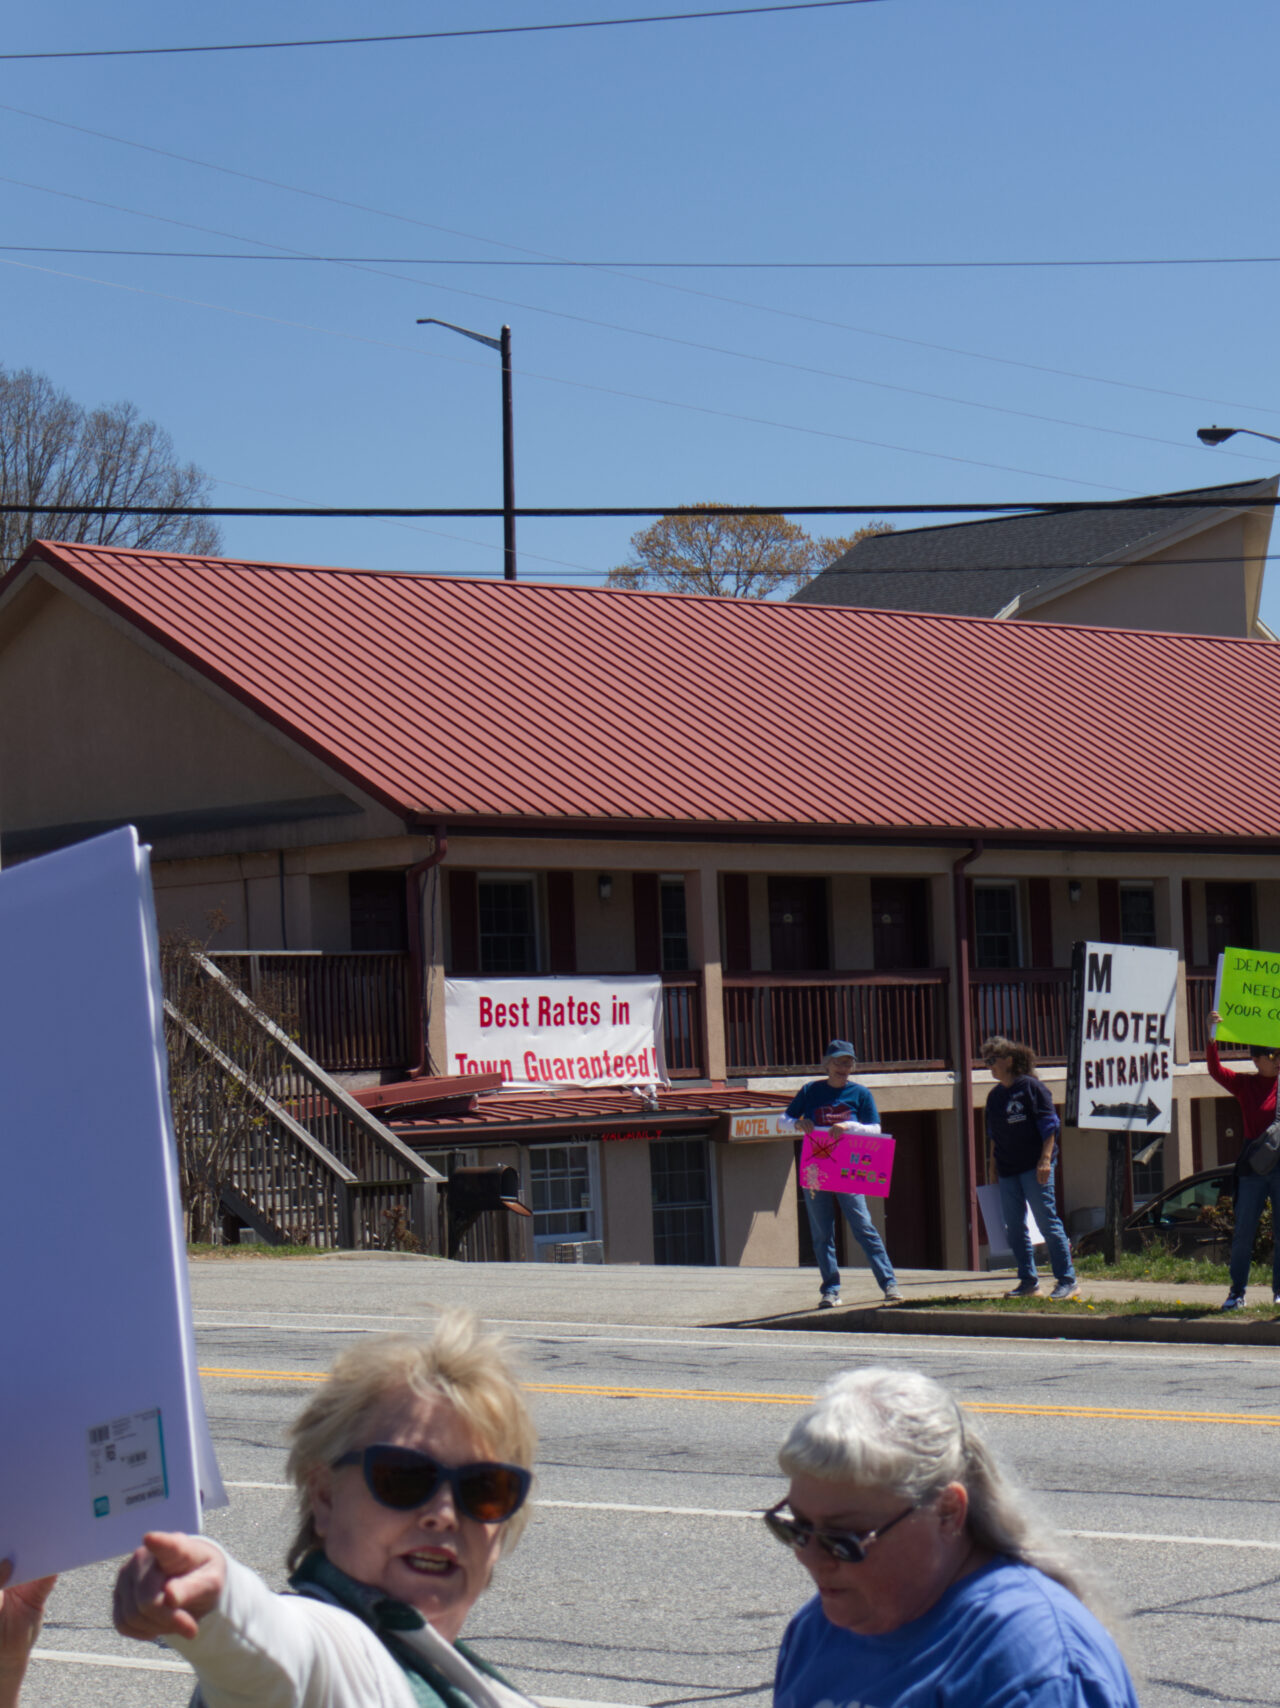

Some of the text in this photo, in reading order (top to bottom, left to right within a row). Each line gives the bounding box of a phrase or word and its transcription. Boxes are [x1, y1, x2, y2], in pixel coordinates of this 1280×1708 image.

[1088, 952, 1112, 993] M
[479, 994, 630, 1027] Best Rates in
[1224, 1001, 1261, 1018] YOUR
[1086, 1008, 1170, 1047] MOTEL
[523, 1047, 659, 1082] Guaranteed!
[1085, 1051, 1169, 1090] ENTRANCE
[735, 1118, 769, 1137] MOTEL
[841, 1167, 887, 1184] KINGS
[850, 1152, 872, 1166] NO
